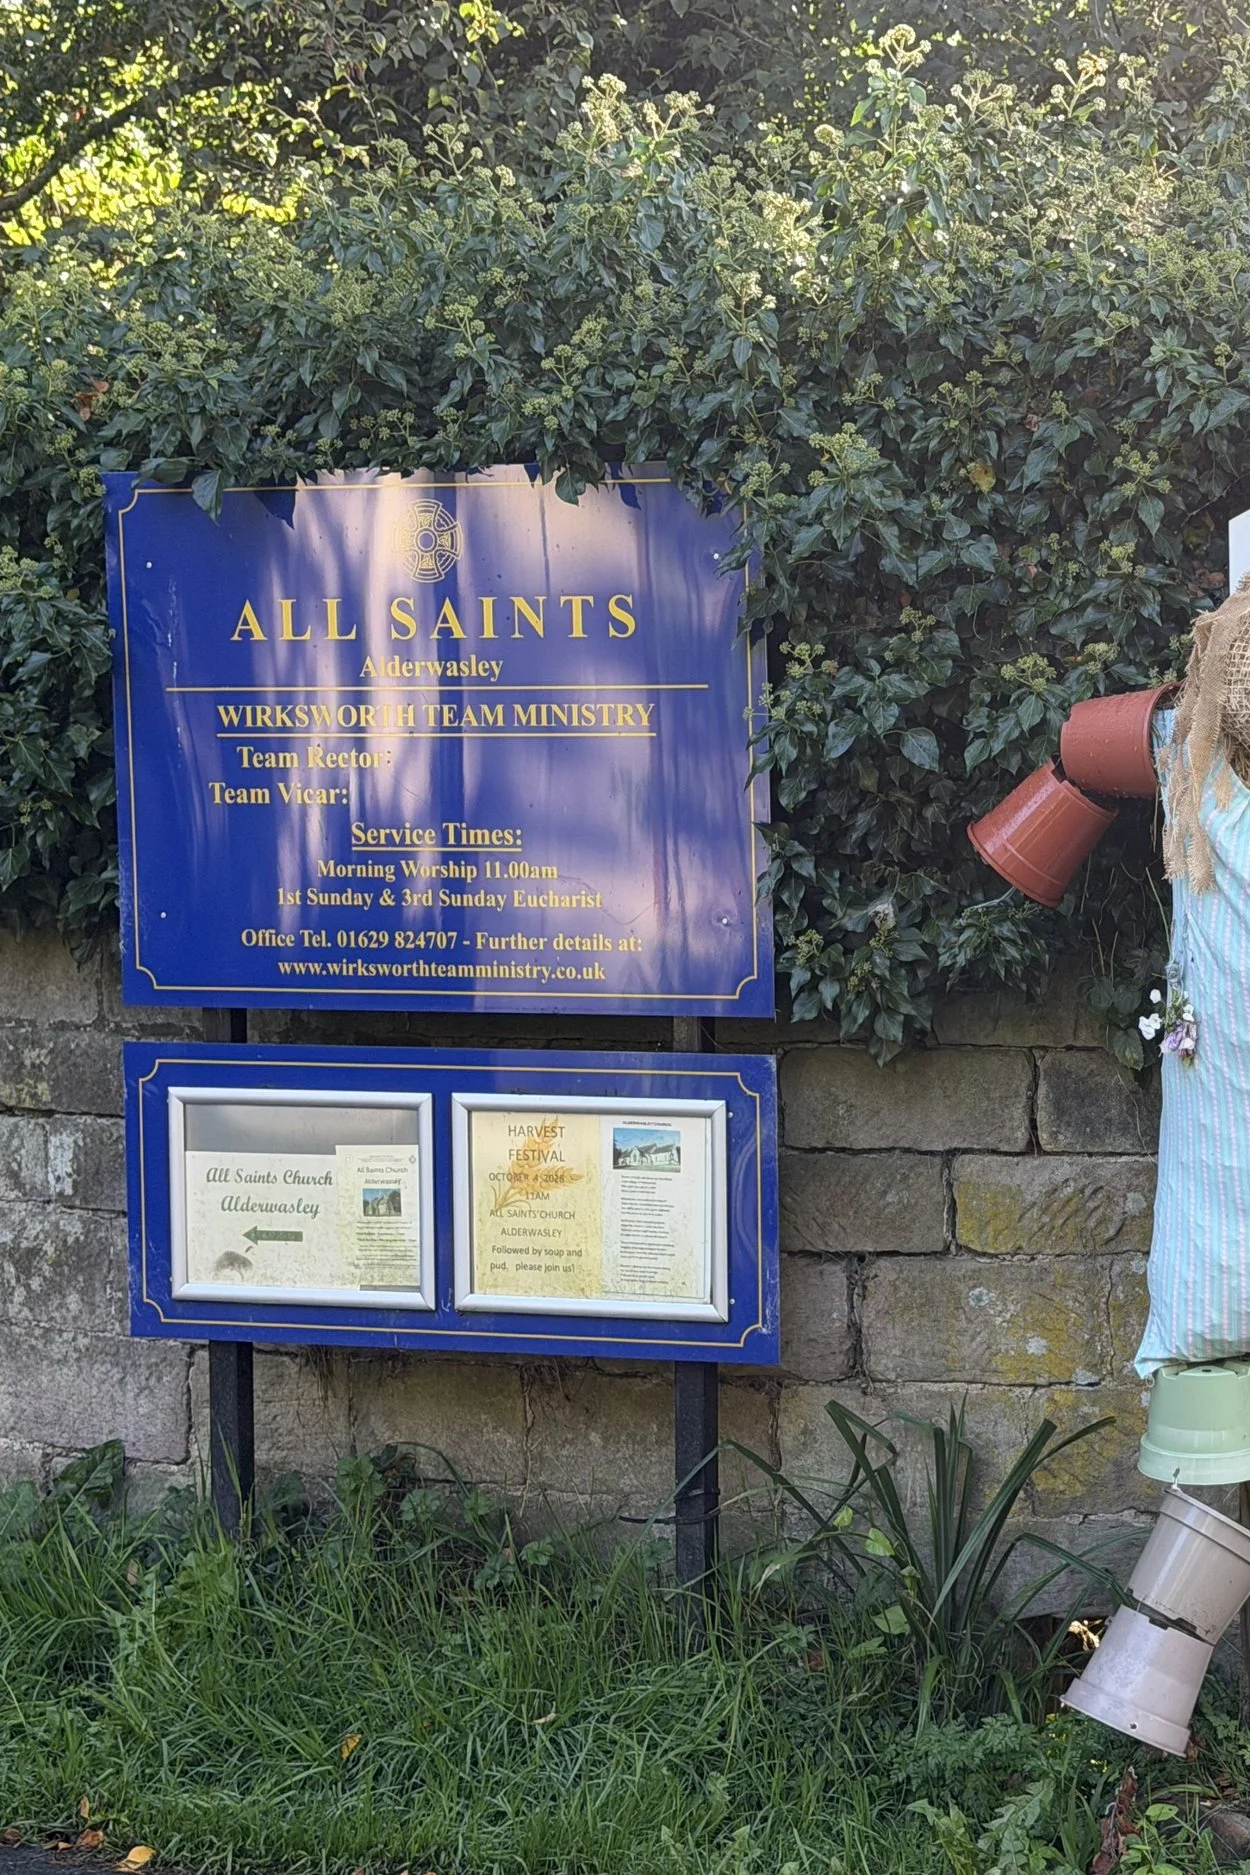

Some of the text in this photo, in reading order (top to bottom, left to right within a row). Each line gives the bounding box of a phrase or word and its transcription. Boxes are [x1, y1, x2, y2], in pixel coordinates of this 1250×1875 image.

[231, 594, 638, 642] ALL SAINTS
[359, 656, 504, 683] Alderwasley
[217, 703, 656, 730] WIRKSWORTH TEAM MINISTRY
[237, 746, 393, 770] Team Rector:
[209, 782, 349, 806] Team Vicar:
[351, 822, 523, 847] Service Times:
[317, 860, 559, 882] Morning Worship 11.00am
[276, 888, 603, 911] 1st Sunday & 3rd Sunday Eucharist
[241, 928, 296, 948] Office
[300, 929, 332, 949] Tel.
[336, 929, 390, 950] 01629
[394, 930, 458, 951] 824707
[475, 931, 548, 952] Further
[552, 932, 613, 953] details
[617, 934, 643, 953] at:
[278, 958, 606, 985] www.wirksworthteamministry.co.uk
[508, 1125, 566, 1138] HARVEST
[508, 1148, 566, 1163] FESTIVAL
[206, 1167, 333, 1186] All Saints Church
[488, 1172, 529, 1182] OCTOBER
[221, 1195, 320, 1220] Alderwasley
[526, 1192, 550, 1201] 11AM
[489, 1209, 504, 1218] ALL
[500, 1227, 562, 1238] ALDERWASLEY
[491, 1245, 582, 1258] Followed by soup and
[515, 1262, 542, 1272] please
[544, 1262, 560, 1273] join
